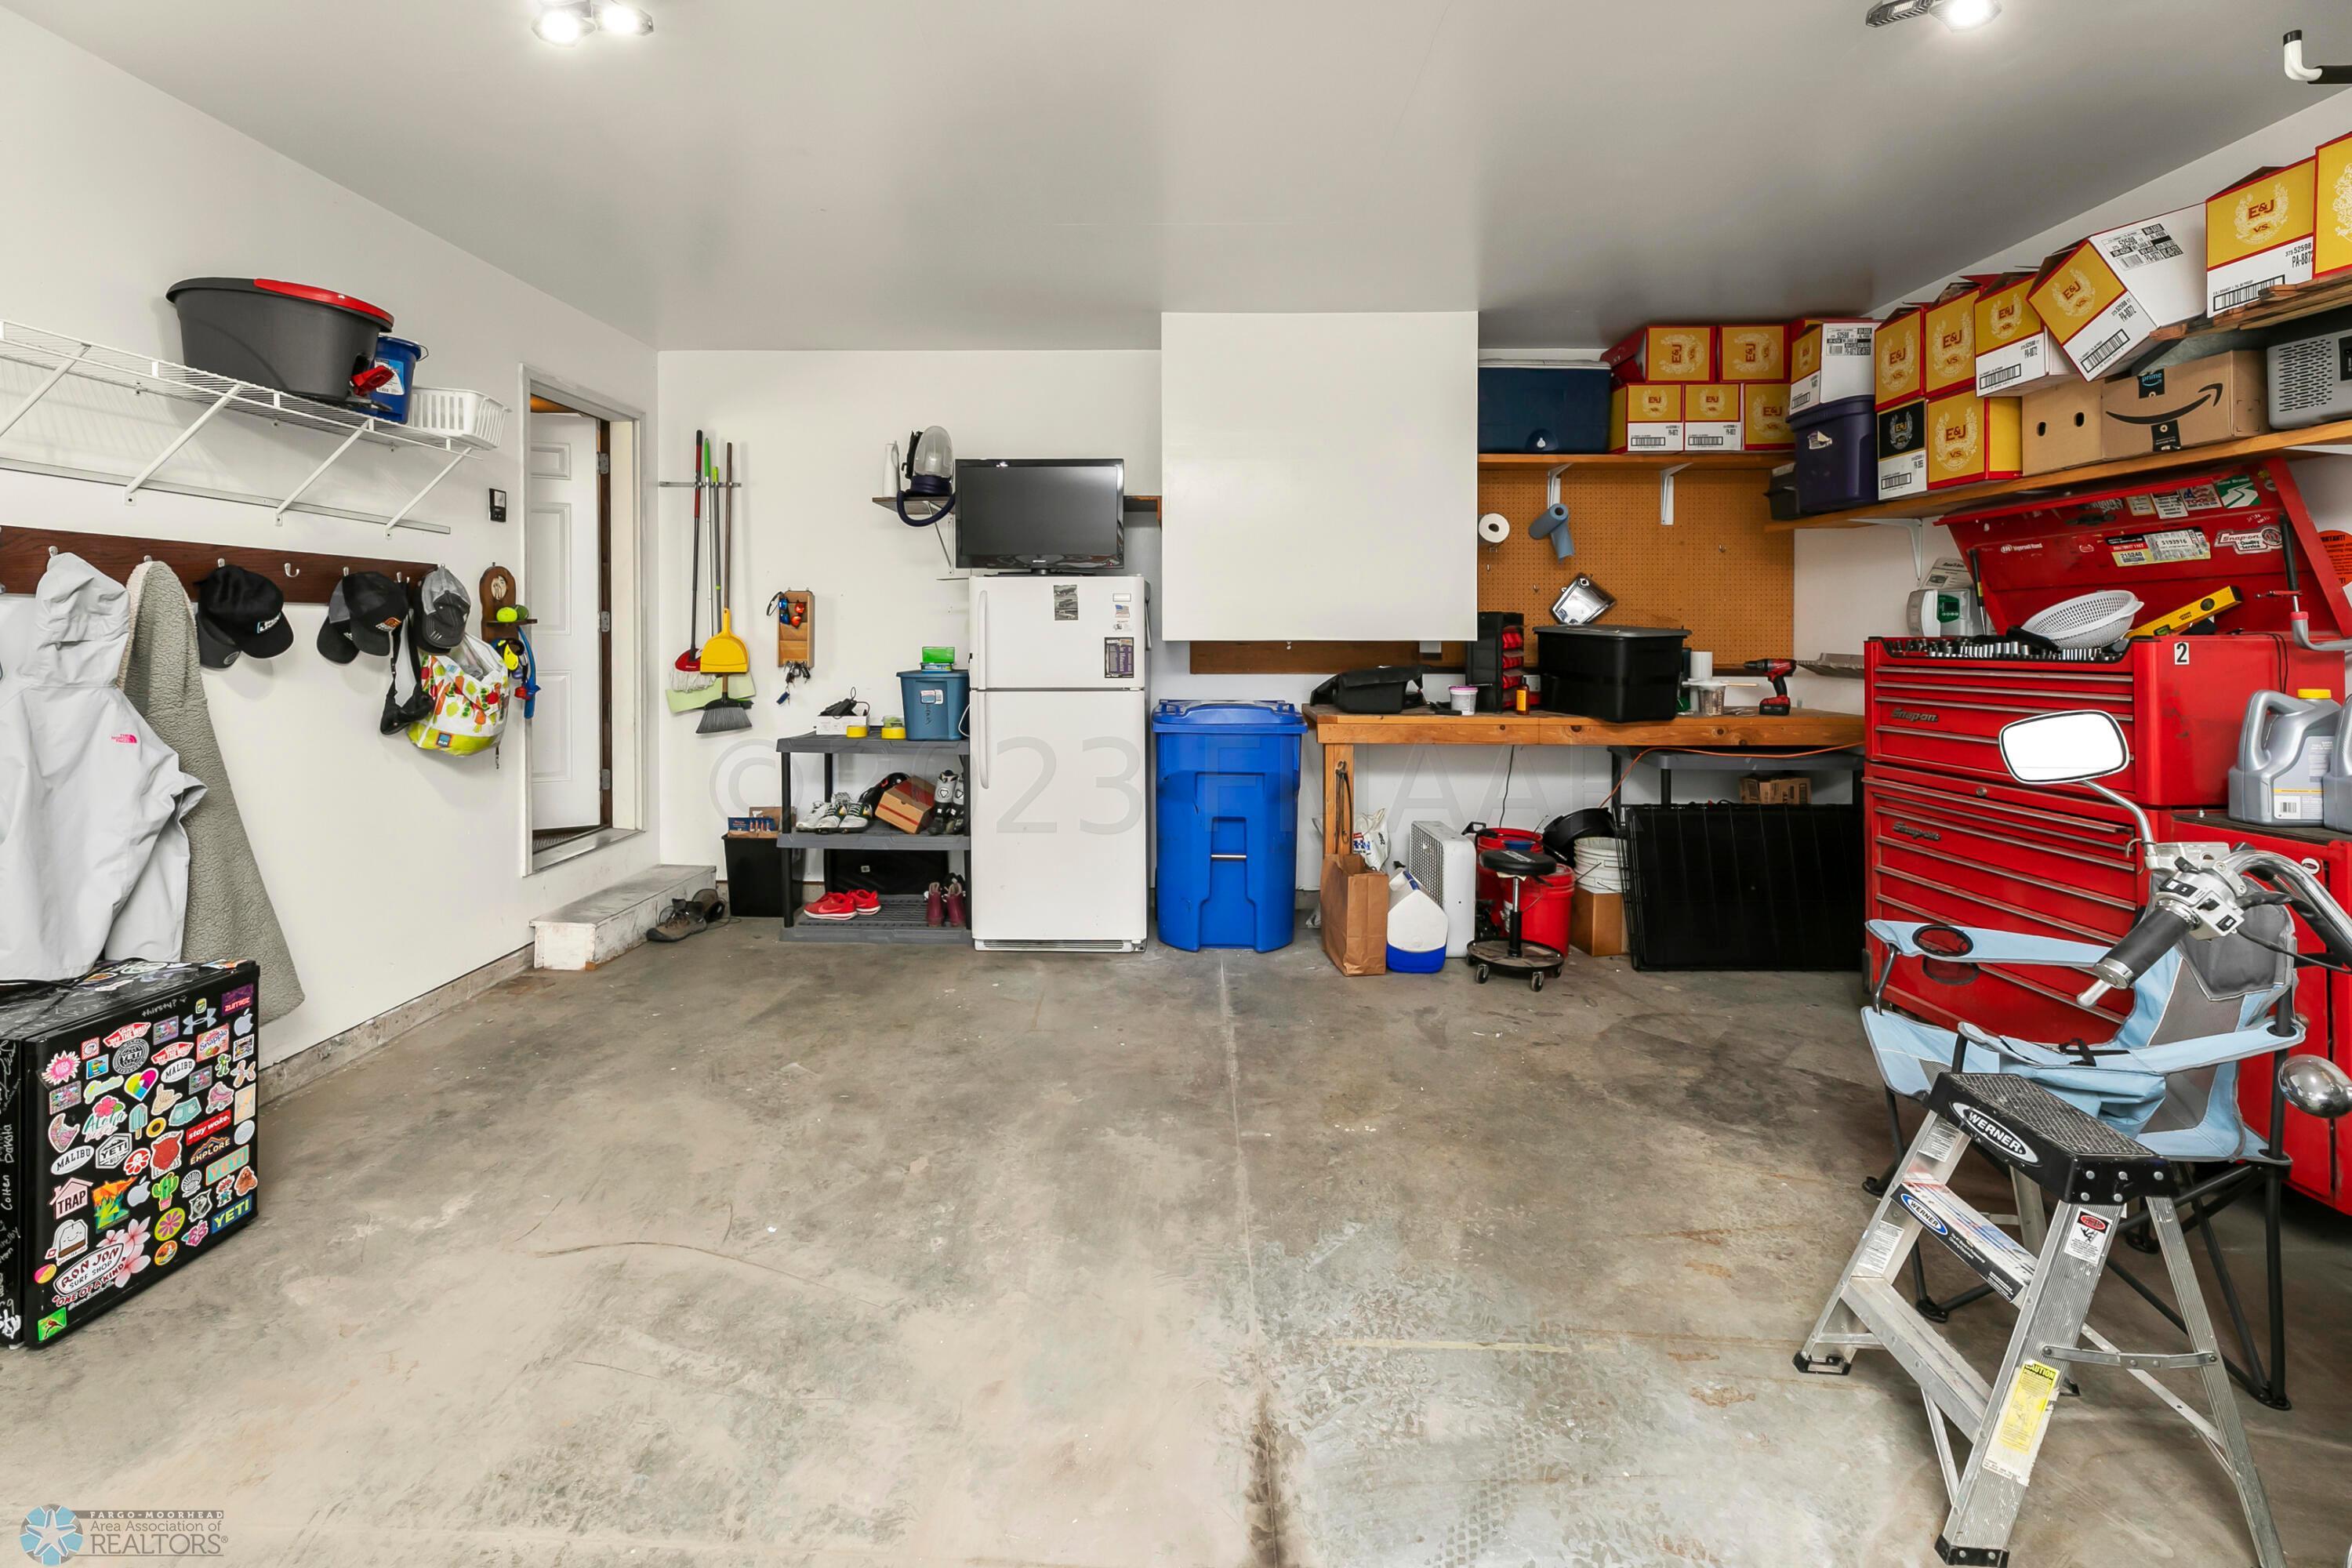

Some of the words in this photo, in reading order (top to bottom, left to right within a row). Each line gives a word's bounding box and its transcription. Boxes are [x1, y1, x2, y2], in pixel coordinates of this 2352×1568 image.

[2249, 199, 2274, 220] E&J
[2294, 242, 2311, 253] 52598
[2062, 281, 2082, 300] E&J
[1998, 304, 2014, 320] E&J
[1942, 329, 1962, 349] E&J
[1671, 344, 1682, 364] E&J
[1745, 343, 1756, 362] E&J
[1889, 348, 1906, 365] E&J
[2142, 372, 2162, 383] prime
[1762, 406, 1783, 416] E&J
[1945, 424, 1967, 441] E&J
[2176, 642, 2187, 663] 2
[142, 999, 177, 1017] thirsty?
[199, 1029, 227, 1051] Snapple
[122, 1051, 142, 1061] YETI
[165, 1061, 193, 1080] MALIBU
[188, 1127, 207, 1139] stay
[207, 1116, 230, 1130] woke.
[56, 1148, 91, 1171] MALIBU
[101, 1142, 128, 1160] YETI
[190, 1138, 230, 1165] EXPLORE
[211, 1151, 245, 1177] YETI
[57, 1190, 86, 1214] TRAP
[214, 1198, 249, 1229] YETI
[1911, 1201, 1939, 1227] WERNER
[61, 1259, 89, 1287] RON
[93, 1247, 119, 1266] JON
[69, 1273, 89, 1289] SURF
[92, 1260, 112, 1276] SHOP
[79, 1285, 93, 1298] OF
